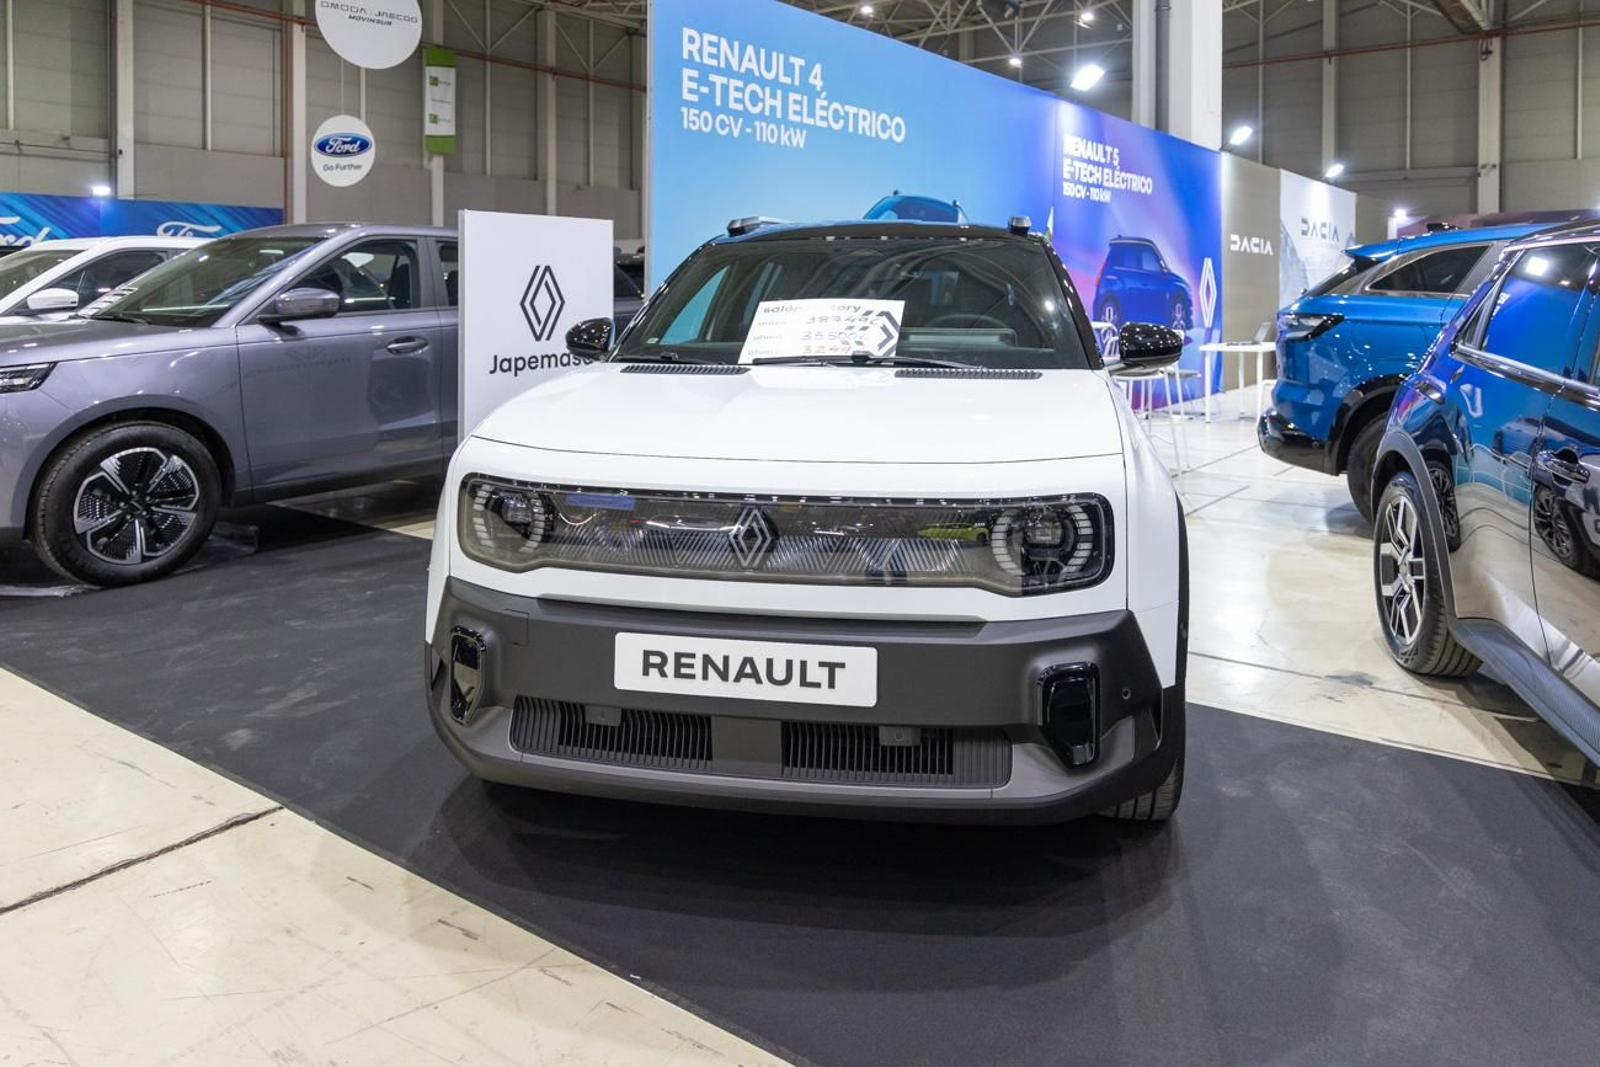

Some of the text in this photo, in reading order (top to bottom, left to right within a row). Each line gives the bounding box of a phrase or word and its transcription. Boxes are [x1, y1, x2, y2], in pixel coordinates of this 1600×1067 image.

[682, 27, 824, 91] RENAULT 4
[682, 68, 906, 143] E-TECH ELÉCTRICO
[326, 135, 361, 154] Ford
[681, 107, 712, 133] 150
[715, 114, 744, 138] CV
[755, 121, 778, 144] 110
[780, 125, 806, 149] kW
[323, 162, 363, 171] Go Further
[1063, 134, 1120, 167] RENAULT 5
[1063, 158, 1153, 195] E-TECH ELÉCTRICO
[1075, 184, 1087, 199] CV
[1230, 234, 1274, 256] DACIA
[1301, 217, 1340, 242] DACIA
[642, 649, 846, 690] RENAULT
